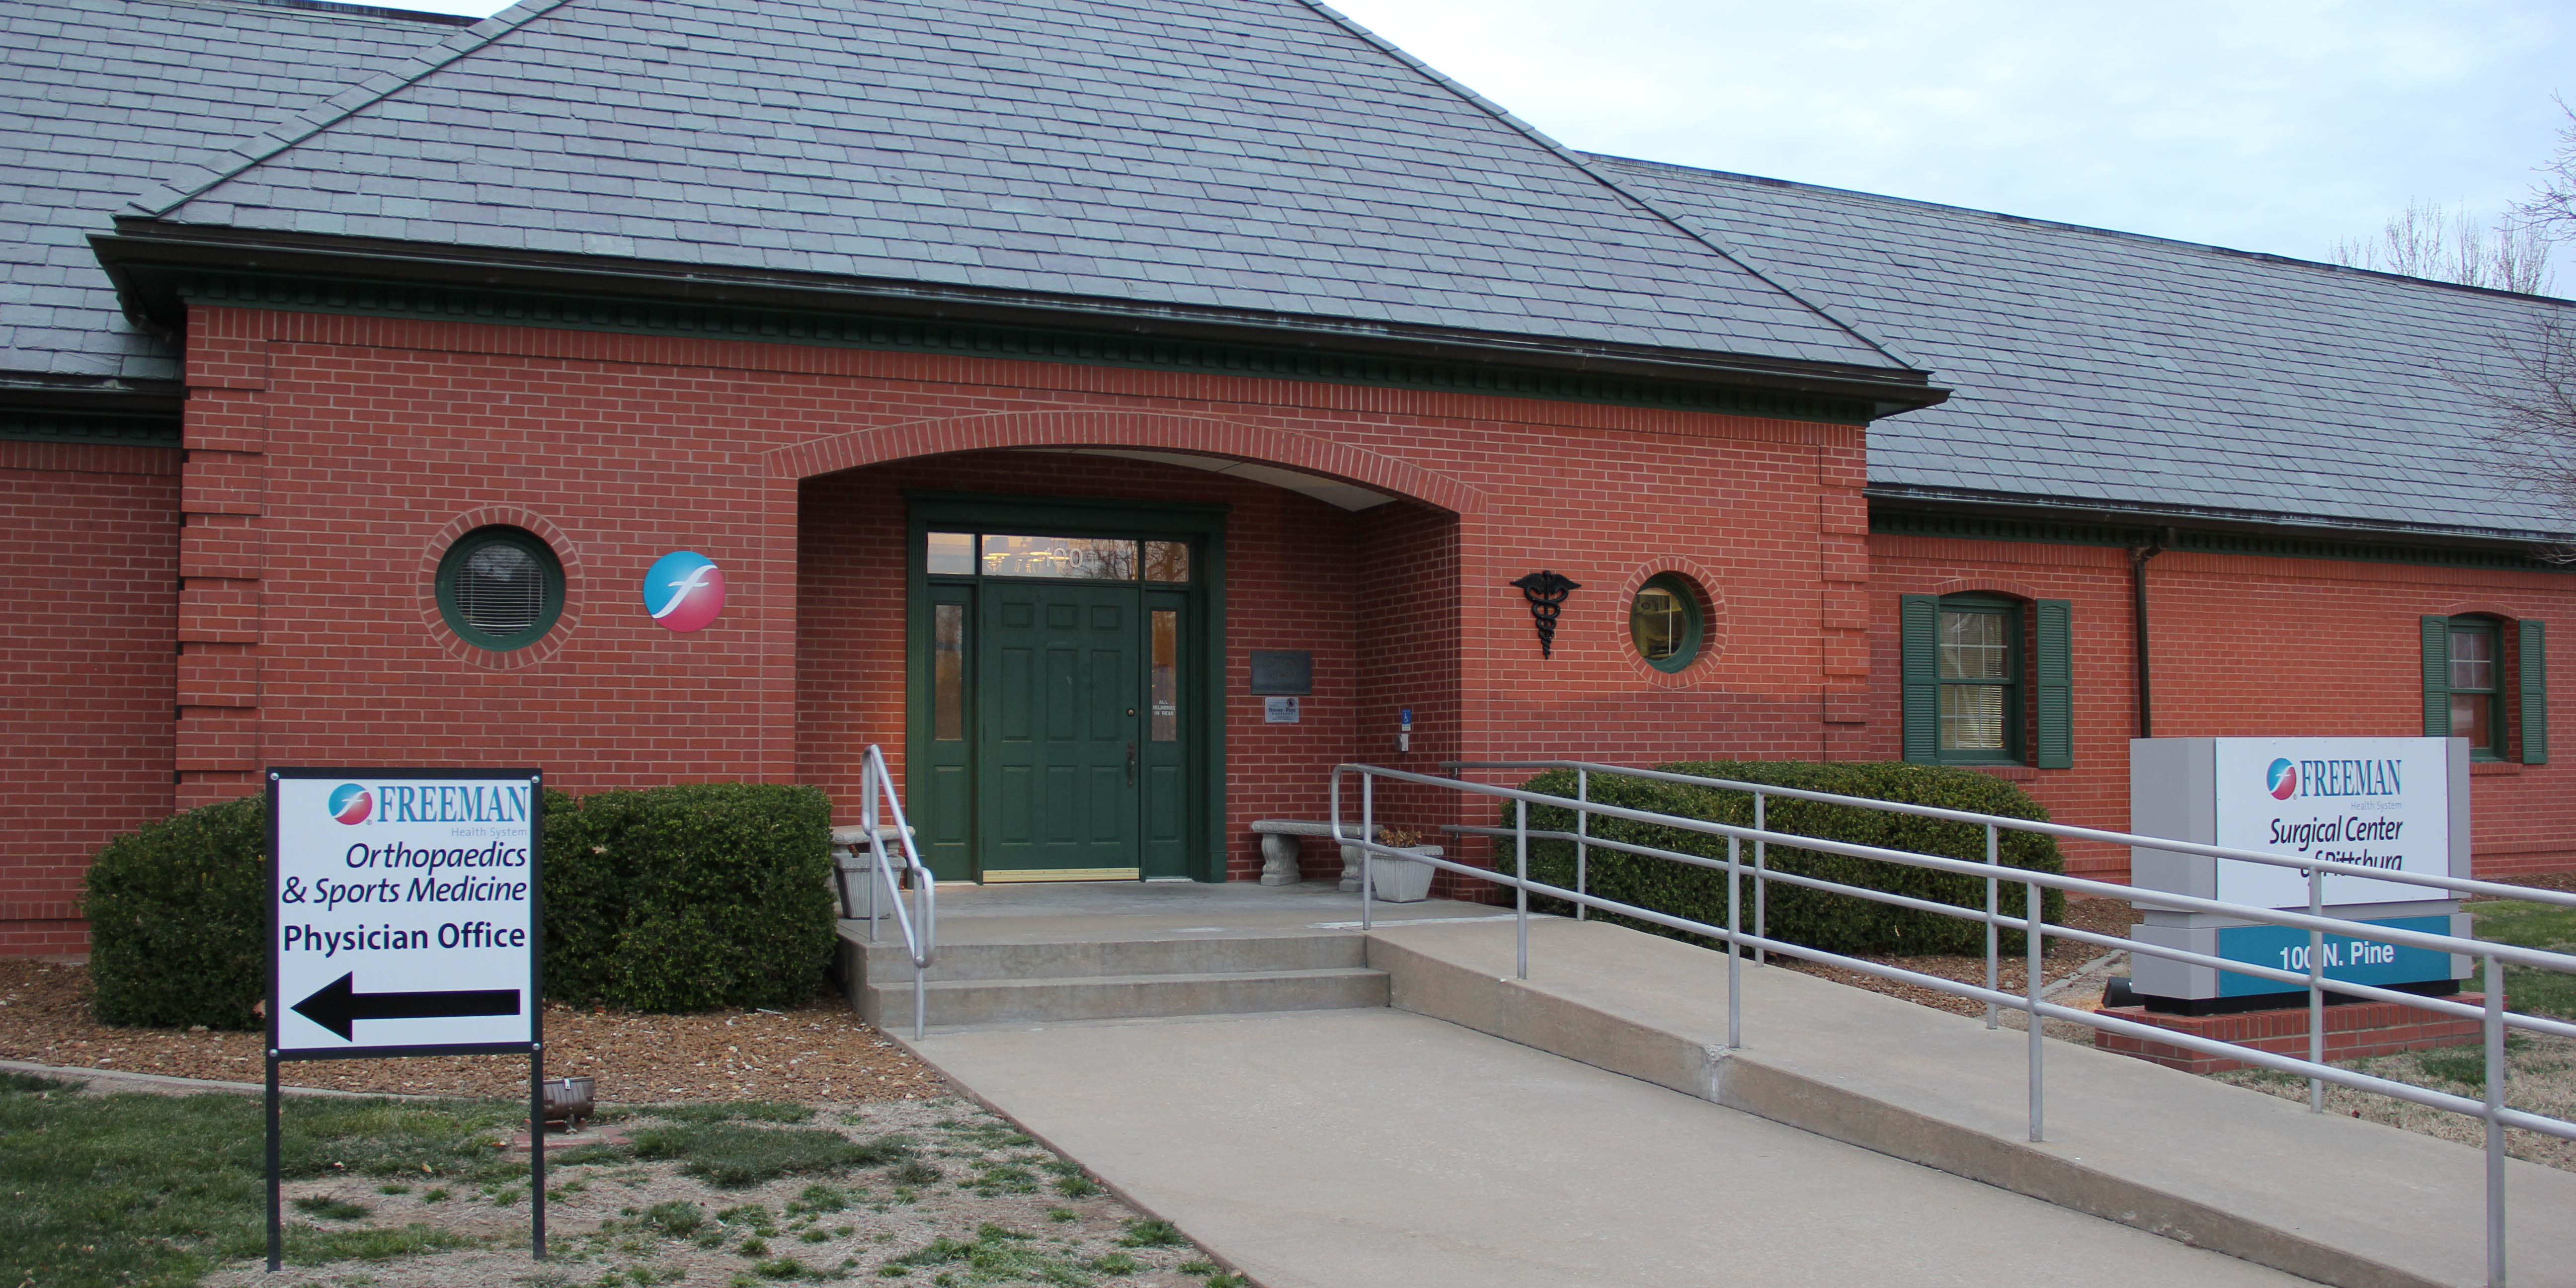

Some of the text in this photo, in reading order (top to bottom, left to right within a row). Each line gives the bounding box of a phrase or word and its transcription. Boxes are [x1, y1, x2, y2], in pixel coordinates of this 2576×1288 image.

[1044, 547, 1083, 567] 100
[2299, 759, 2402, 797] FREEMAN
[377, 786, 529, 822] FREEMAN
[2351, 801, 2402, 812] Health System
[451, 827, 527, 839] Health System
[2269, 815, 2403, 852] Surgical Center
[346, 841, 527, 876] Orthopaedics
[282, 875, 527, 912] & Sports Medicine
[284, 921, 525, 958] Physician Office
[2323, 943, 2344, 967] N.
[2350, 941, 2395, 965] Pine
